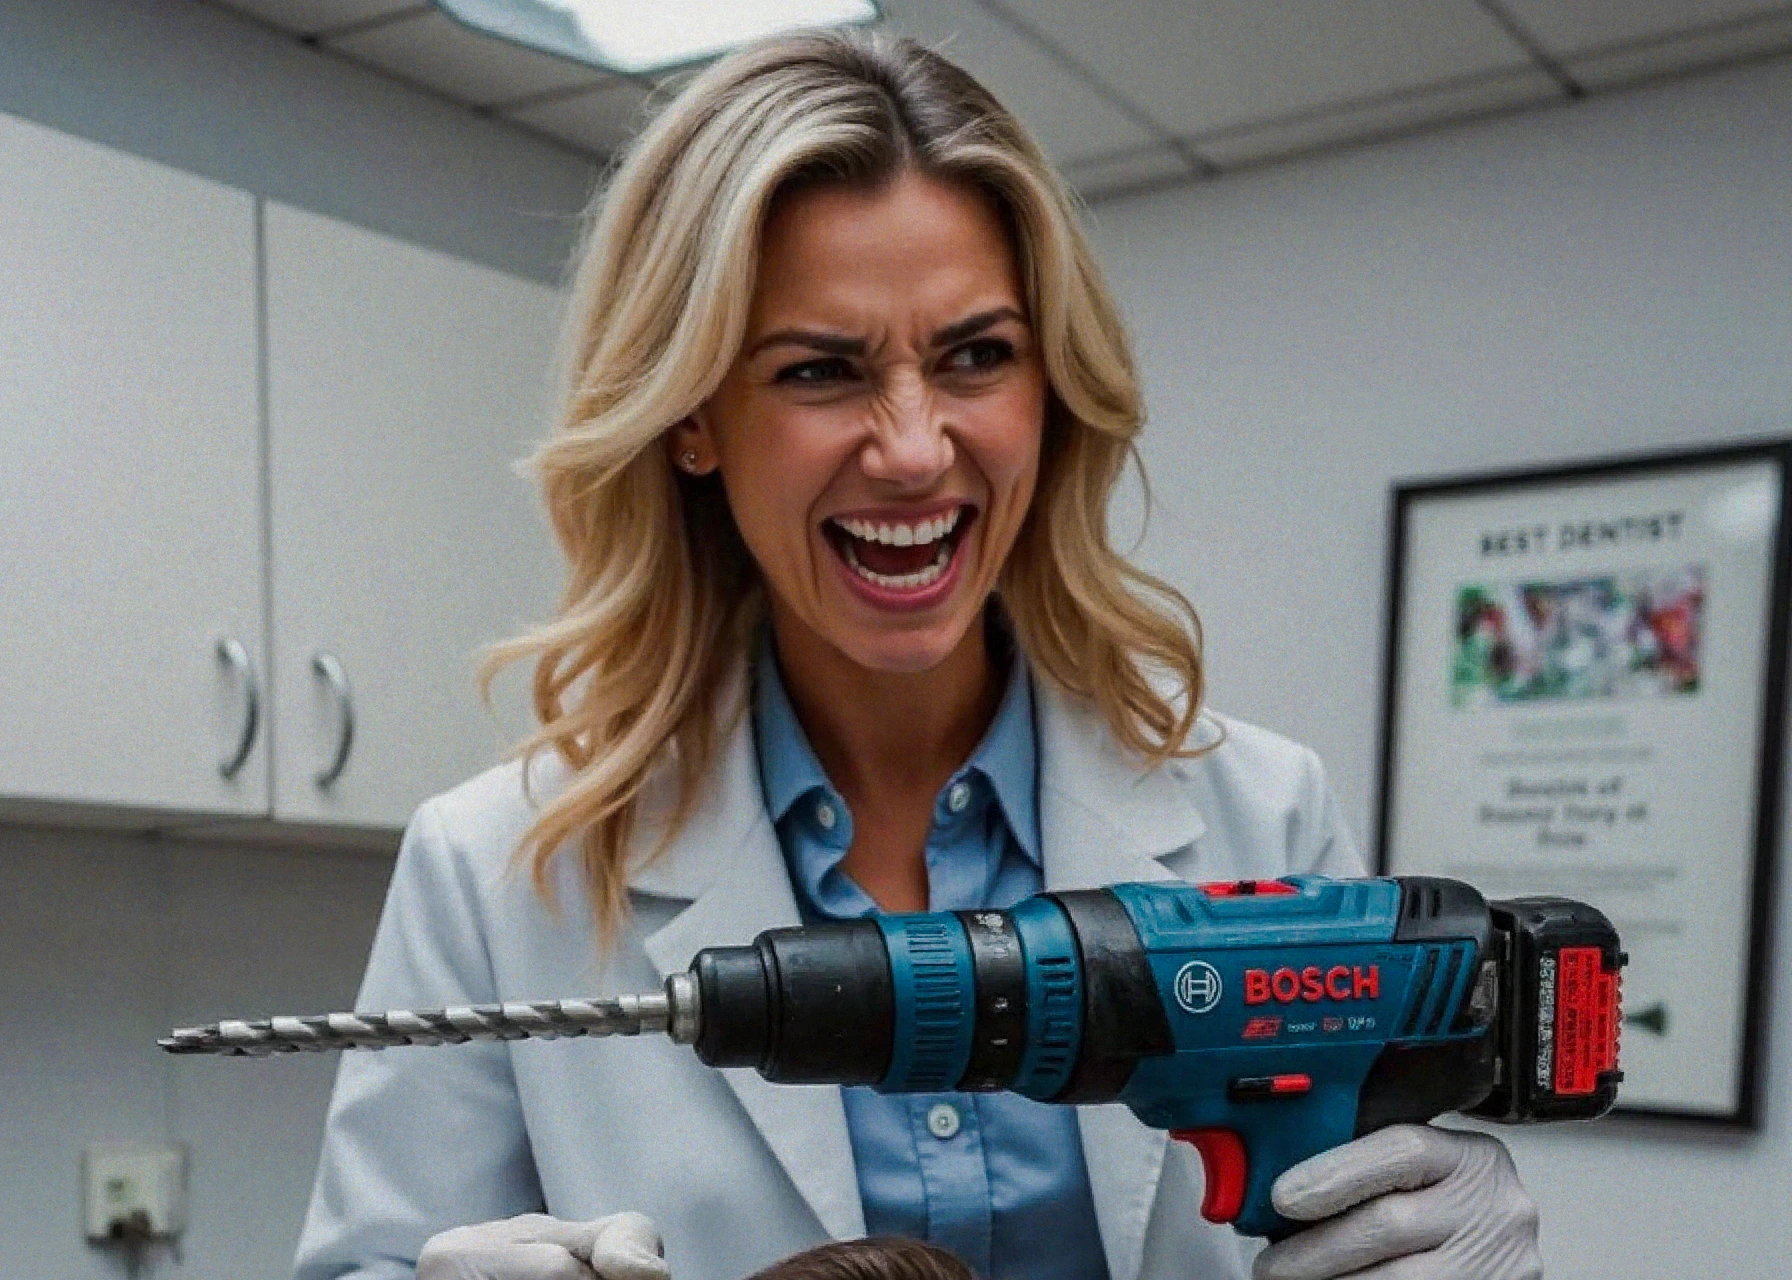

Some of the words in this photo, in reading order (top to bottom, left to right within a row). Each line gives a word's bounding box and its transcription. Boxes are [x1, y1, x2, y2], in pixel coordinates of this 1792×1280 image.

[1481, 526, 1547, 554] BEST
[1560, 511, 1684, 549] DENTIST
[1244, 965, 1380, 1004] BOSCH
